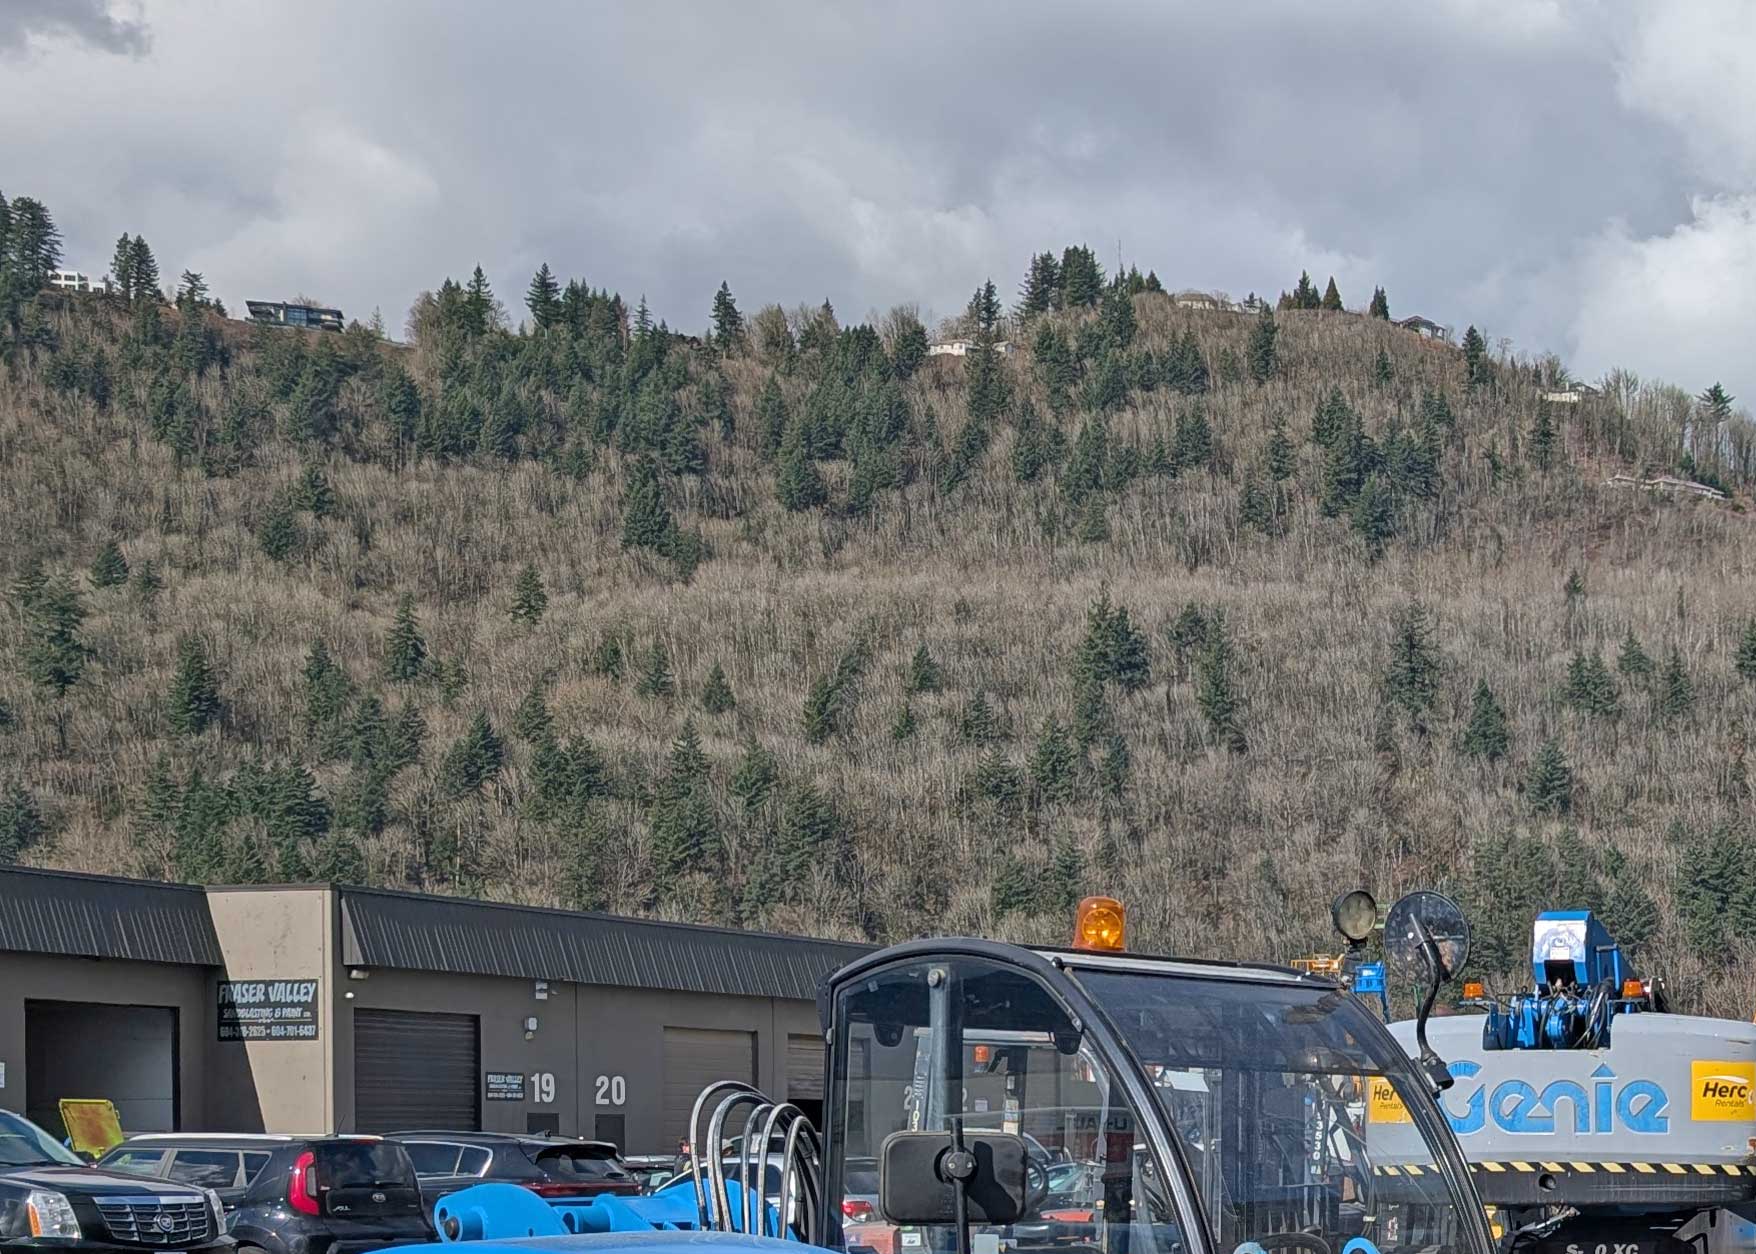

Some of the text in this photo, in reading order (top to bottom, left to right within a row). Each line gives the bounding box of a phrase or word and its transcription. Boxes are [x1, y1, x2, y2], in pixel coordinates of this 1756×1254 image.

[218, 982, 316, 1004] FRASER VALLEY
[530, 1073, 555, 1103] 19
[595, 1075, 626, 1105] 20
[1373, 1085, 1397, 1101] Her
[1442, 1061, 1671, 1135] Genie
[1702, 1082, 1748, 1099] Herc
